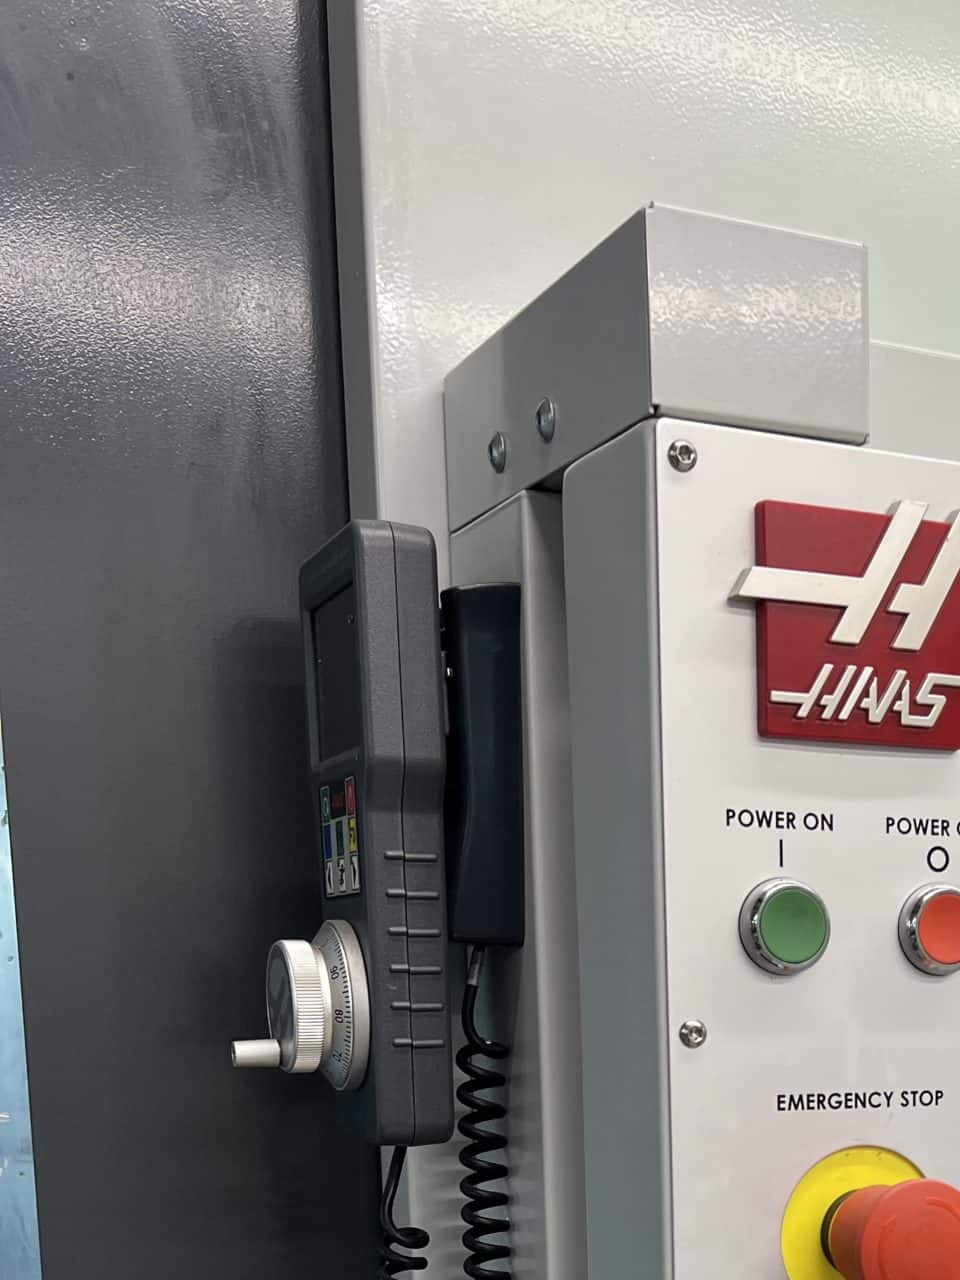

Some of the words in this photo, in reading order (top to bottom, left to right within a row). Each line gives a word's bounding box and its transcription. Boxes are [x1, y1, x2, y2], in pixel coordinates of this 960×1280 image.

[725, 809, 796, 830] POWER
[803, 811, 834, 832] ON
[886, 817, 951, 838] POWER
[334, 1009, 344, 1025] 80
[776, 1091, 895, 1112] EMERGENCY
[900, 1089, 944, 1108] STOP
